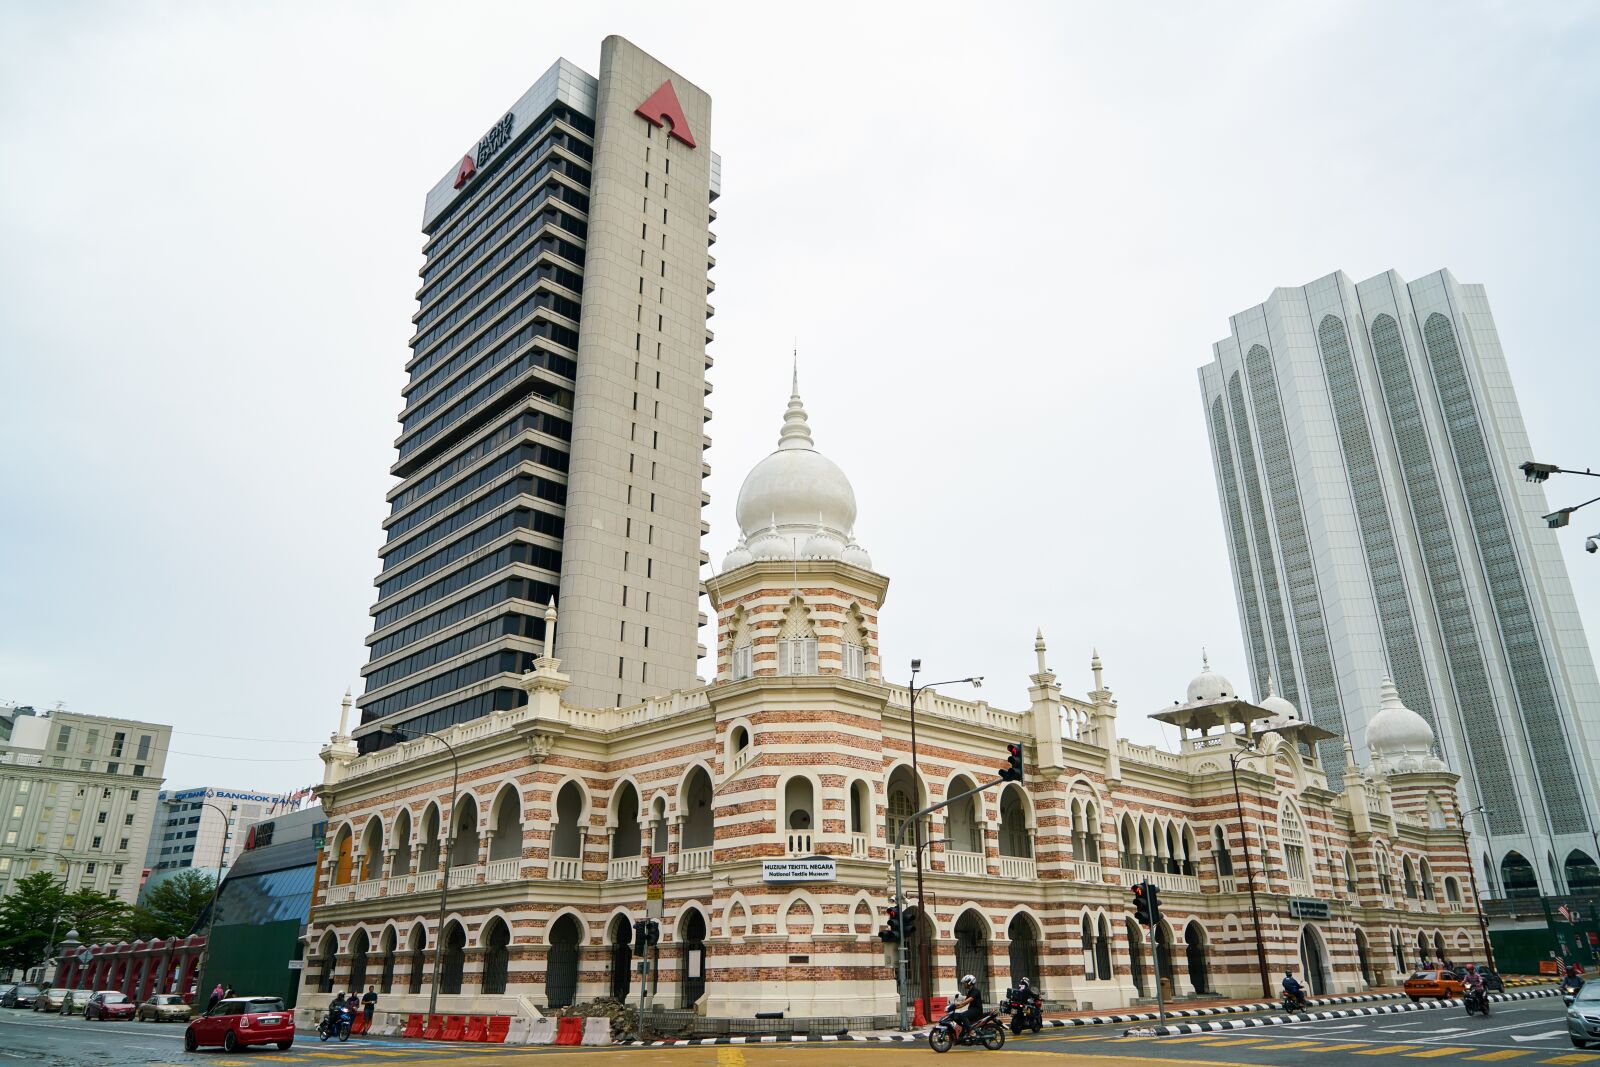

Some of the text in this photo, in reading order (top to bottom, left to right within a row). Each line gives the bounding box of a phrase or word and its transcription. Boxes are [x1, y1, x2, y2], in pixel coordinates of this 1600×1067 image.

[479, 124, 513, 167] BANK
[480, 112, 513, 153] AGRO
[216, 792, 302, 808] BANGKOK BANK
